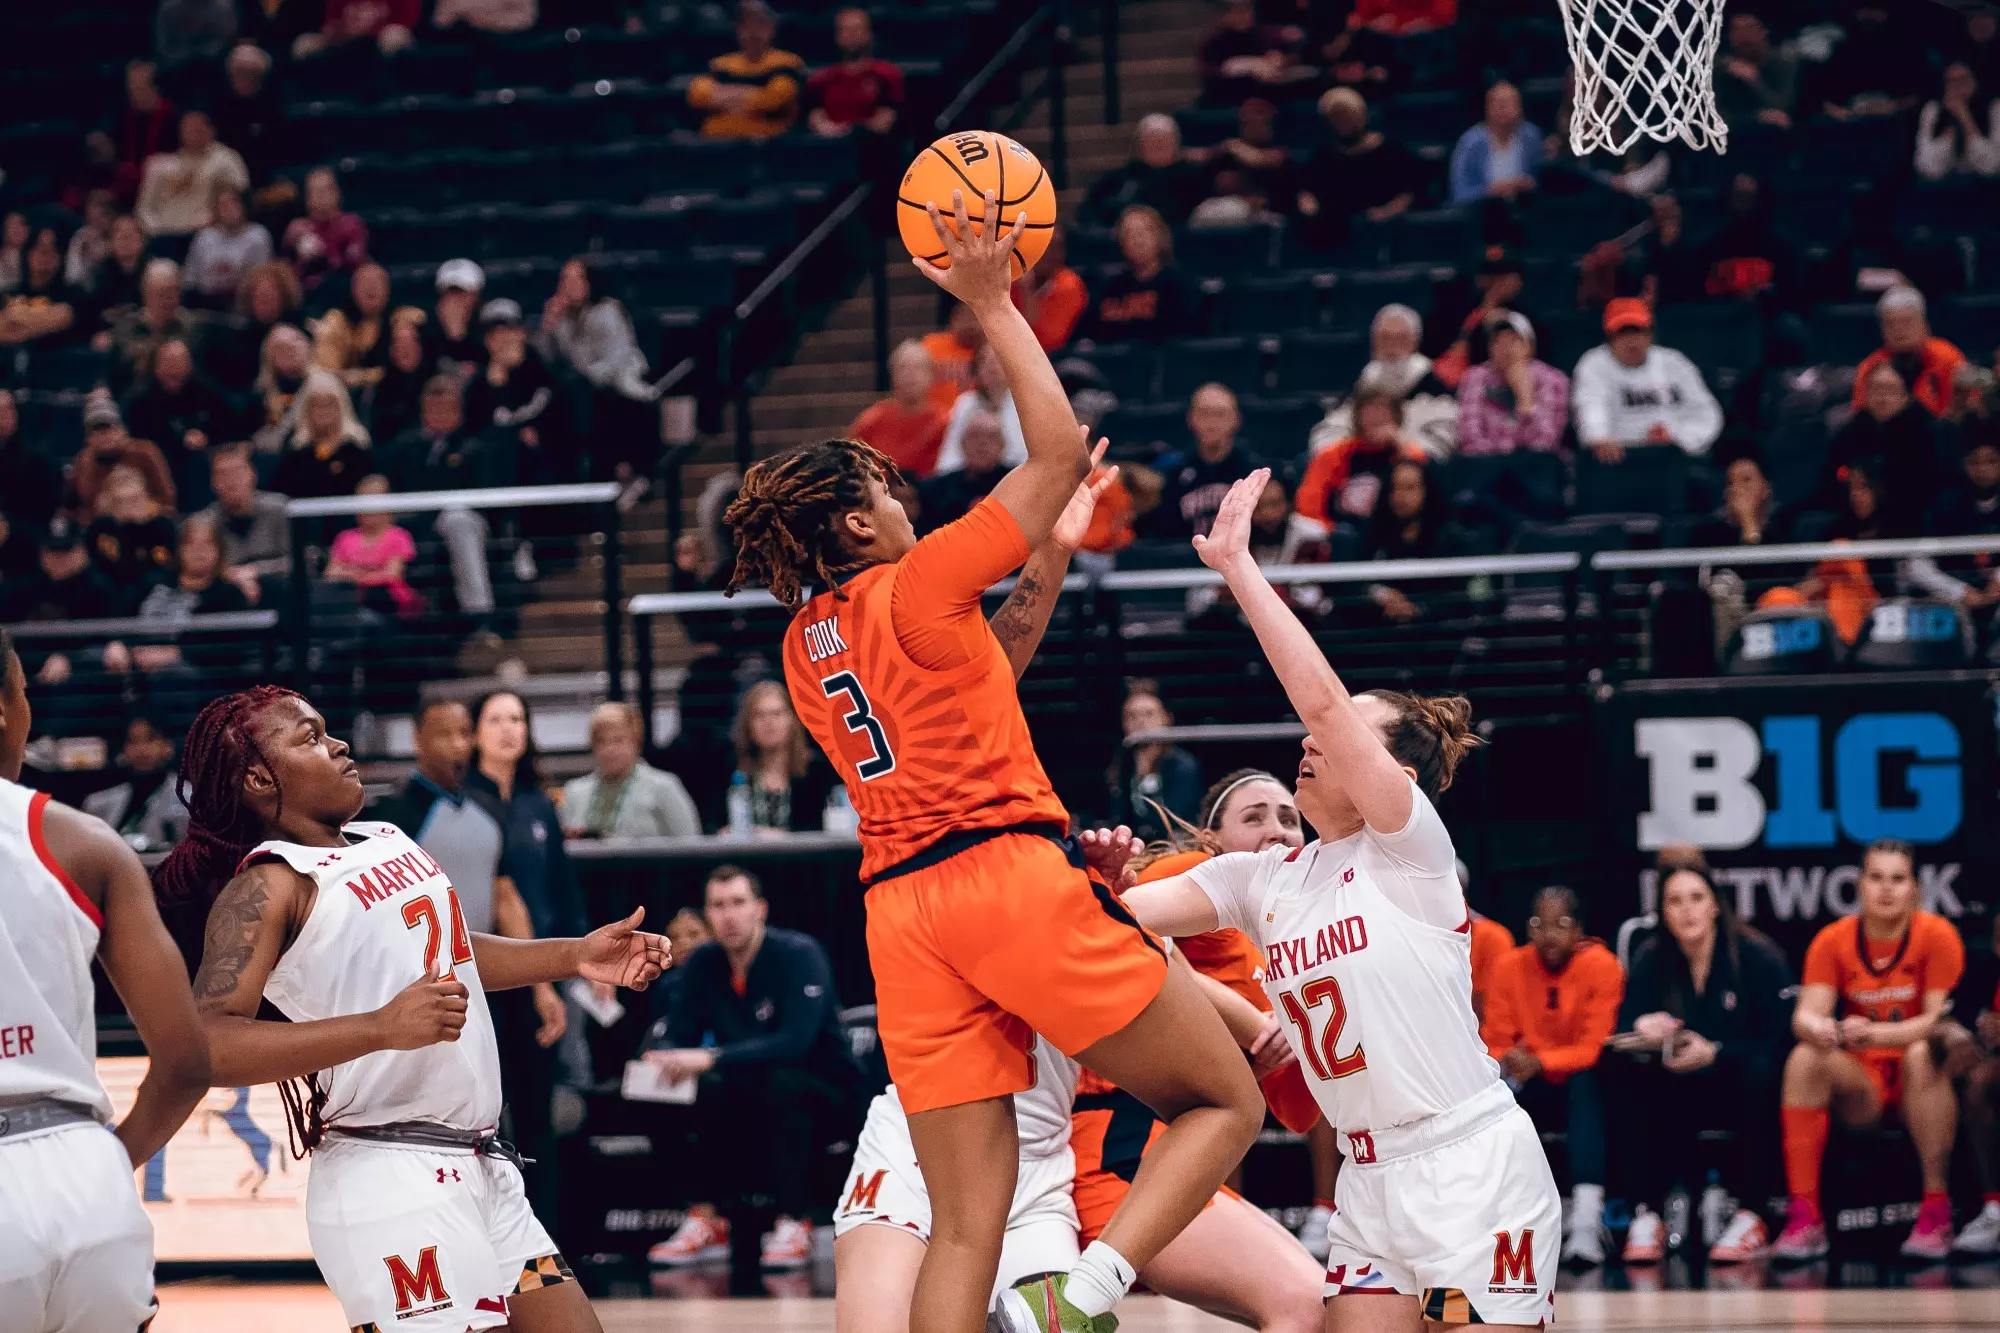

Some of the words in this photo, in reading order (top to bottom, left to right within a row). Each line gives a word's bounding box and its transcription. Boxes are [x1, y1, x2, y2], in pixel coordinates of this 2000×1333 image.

[804, 615, 849, 663] COOK
[820, 669, 896, 782] 3
[345, 848, 446, 912] MARYLA
[1638, 862, 1965, 921] TWOK
[401, 886, 473, 983] 24
[1279, 975, 1367, 1081] 12
[1352, 1136, 1369, 1158] M
[843, 1168, 890, 1213] M
[383, 1245, 451, 1312] M
[1489, 1229, 1537, 1285] M
